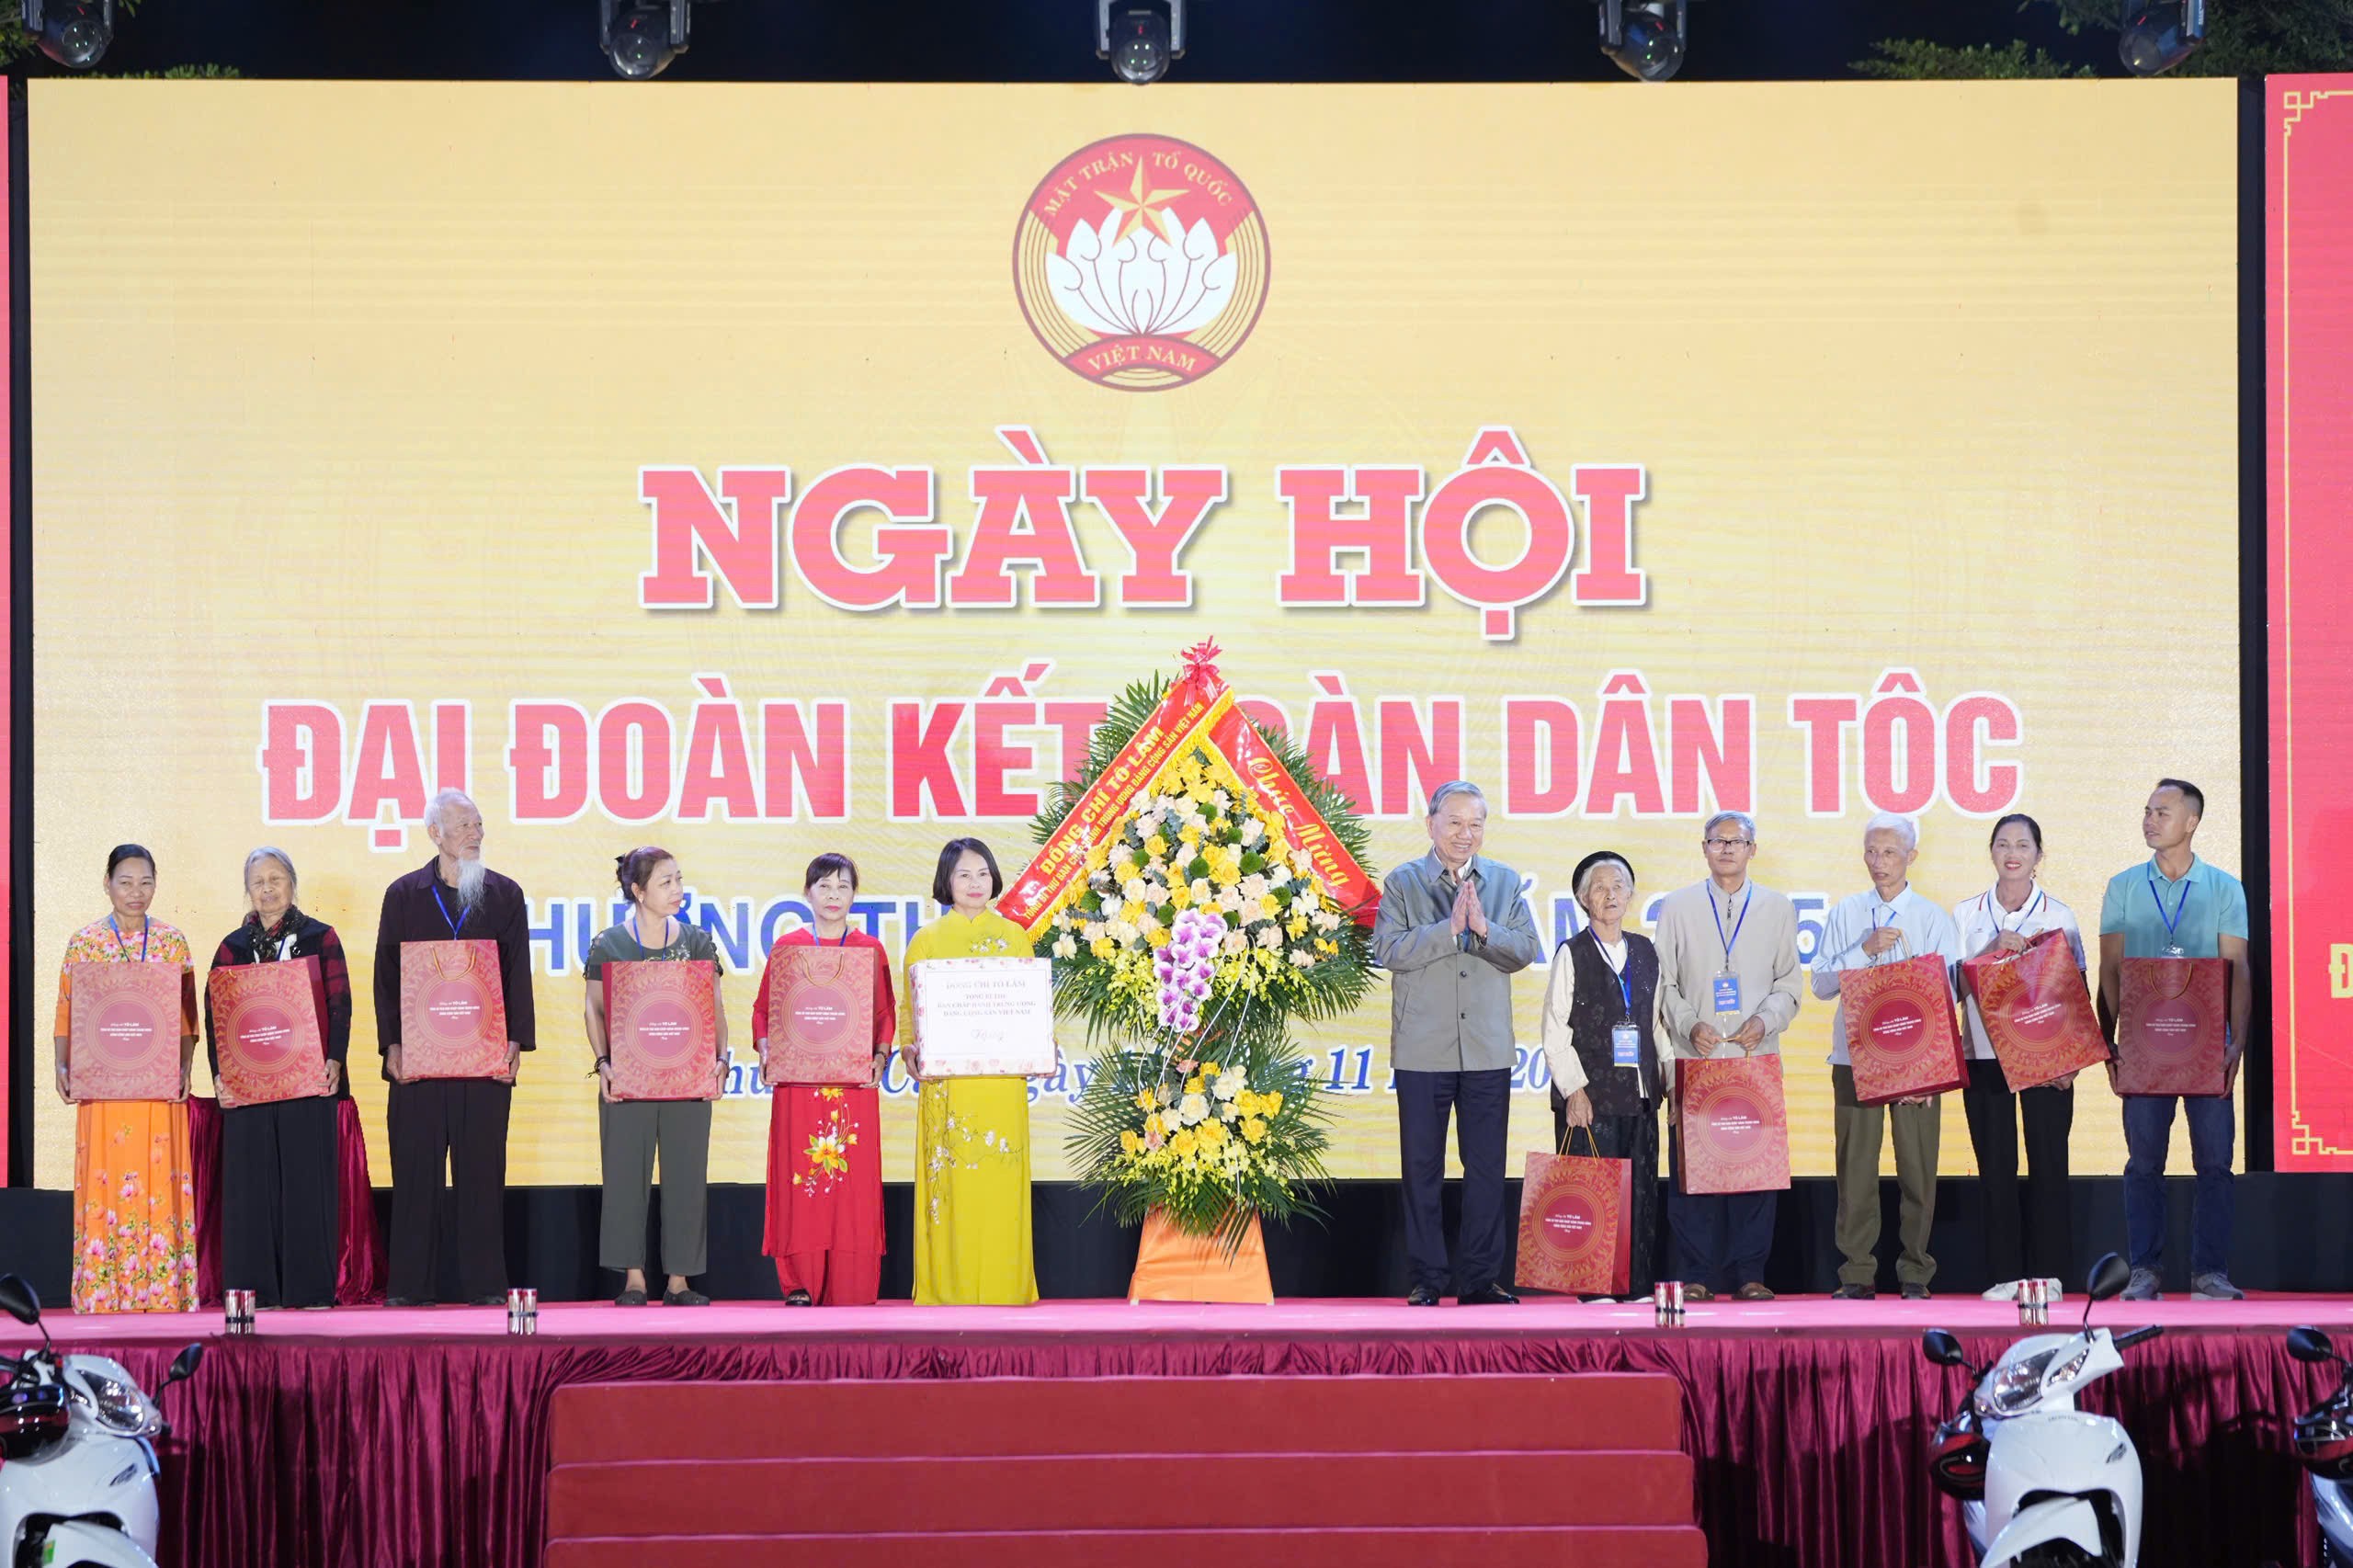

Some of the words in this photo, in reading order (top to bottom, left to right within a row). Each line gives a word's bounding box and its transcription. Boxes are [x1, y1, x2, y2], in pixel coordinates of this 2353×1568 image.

[1078, 150, 1133, 181] TRẬN
[1184, 163, 1233, 207] QUỐC
[1087, 343, 1141, 370] VIỆT
[1146, 346, 1197, 372] NAM
[641, 428, 1225, 608] NGÀY
[1278, 428, 1643, 637] HỘI
[1174, 716, 1190, 733] VIỆT
[1187, 702, 1205, 720] NAM
[261, 703, 467, 848] ĐẠI
[507, 676, 846, 820] ĐOÀN
[891, 663, 1108, 818] KẾT
[1506, 673, 1751, 814] DÂN
[1040, 824, 1083, 876] ĐỒNG
[1081, 788, 1111, 824] CHÍ
[1106, 765, 1131, 790] TÔ
[1127, 725, 1165, 767] LÂM
[1291, 824, 1350, 888] Mừng
[1325, 1048, 1371, 1089] 11
[1509, 1047, 1552, 1089] 20
